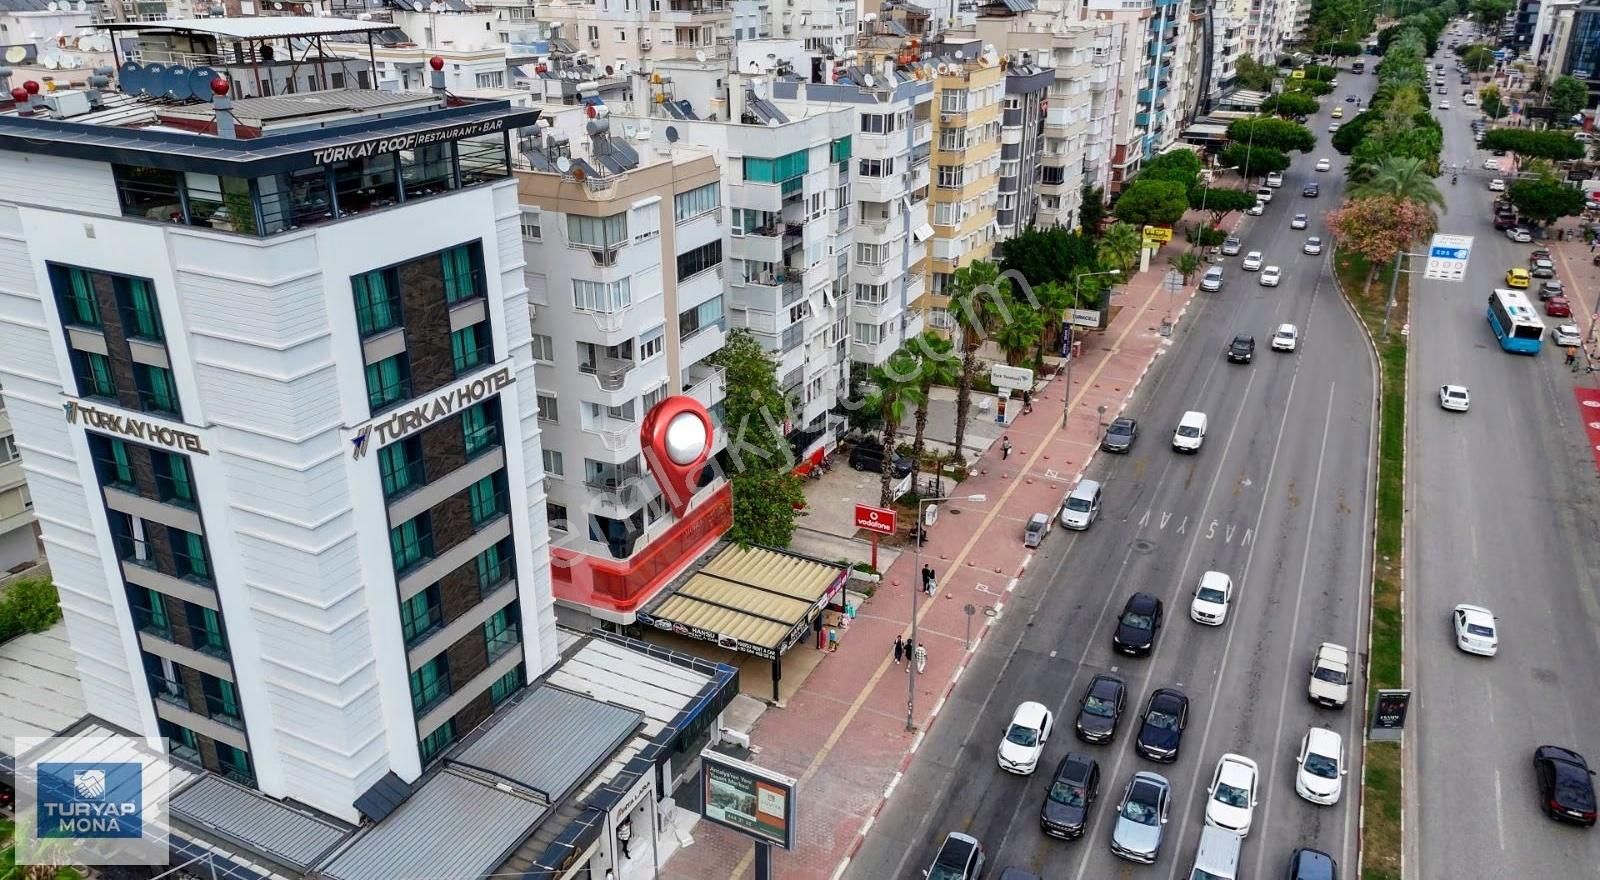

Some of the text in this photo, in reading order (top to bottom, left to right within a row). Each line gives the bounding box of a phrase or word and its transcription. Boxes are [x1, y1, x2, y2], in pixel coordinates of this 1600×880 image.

[314, 119, 503, 165] TÜRKAY ROOF RESTAURANT BAR
[373, 366, 517, 445] TÜRKAY HOTEL
[77, 405, 210, 457] TÜRKAY HOTEL
[858, 518, 891, 531] vodafone
